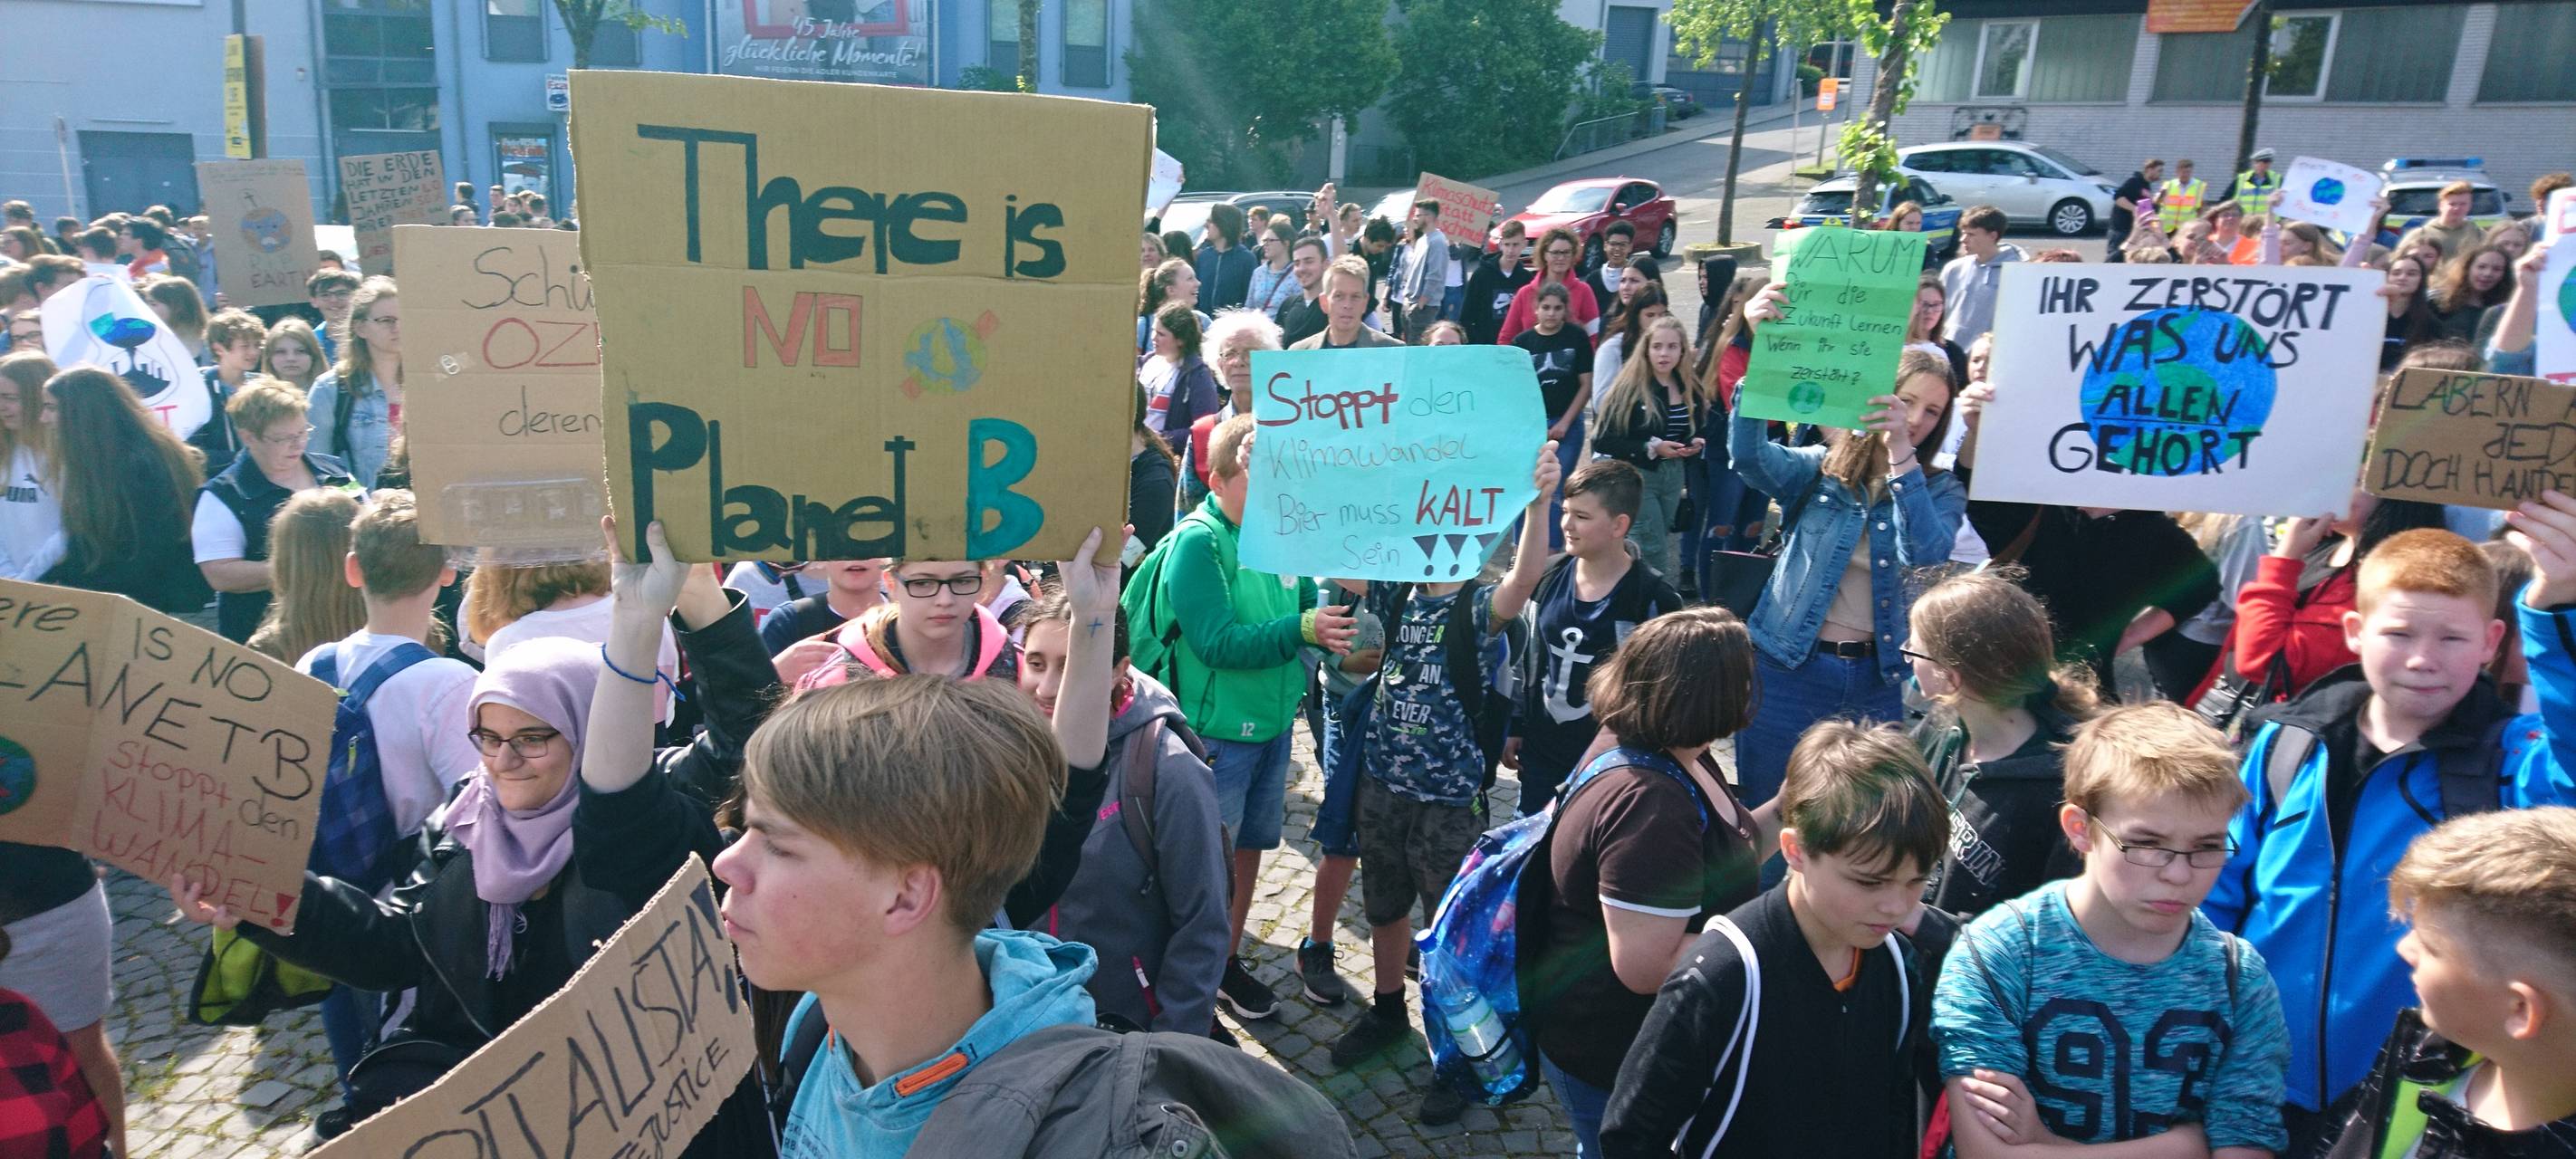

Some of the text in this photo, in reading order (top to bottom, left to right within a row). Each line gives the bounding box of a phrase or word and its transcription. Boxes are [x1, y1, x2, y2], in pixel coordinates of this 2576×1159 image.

[793, 16, 860, 39] 45 Jahre
[724, 34, 922, 67] glückliche Momente!
[346, 152, 432, 177] DIE ERDE
[400, 168, 435, 184] DEN
[350, 185, 420, 205] LETZTEN
[637, 123, 1067, 278] There is
[1790, 231, 1918, 277] WARUM
[1837, 277, 1868, 306] die
[2038, 275, 2351, 330] IHR ZERSTÖRT
[743, 284, 863, 369] NO
[1767, 334, 1802, 352] Wenn
[1850, 340, 1872, 356] sie
[2069, 313, 2302, 375] WAS UNS
[1255, 371, 1475, 430] Stoppt den
[2096, 384, 2242, 426] ALLEN
[2391, 370, 2533, 418] LABERN
[1268, 431, 1479, 481] Klimawandel
[2048, 422, 2264, 477] GEHÖRT
[2381, 448, 2462, 493] DOCH
[4, 485, 39, 503] UMA
[627, 400, 1045, 562] Planet B
[1275, 493, 1328, 536] Bier
[1340, 501, 1401, 524] muss
[1340, 534, 1401, 571] Sein
[1396, 625, 1447, 645] ONGER
[133, 618, 174, 661] IS
[191, 647, 273, 703] NO
[1240, 722, 1255, 737] 12
[1392, 700, 1432, 724] EVER
[238, 790, 300, 840] den
